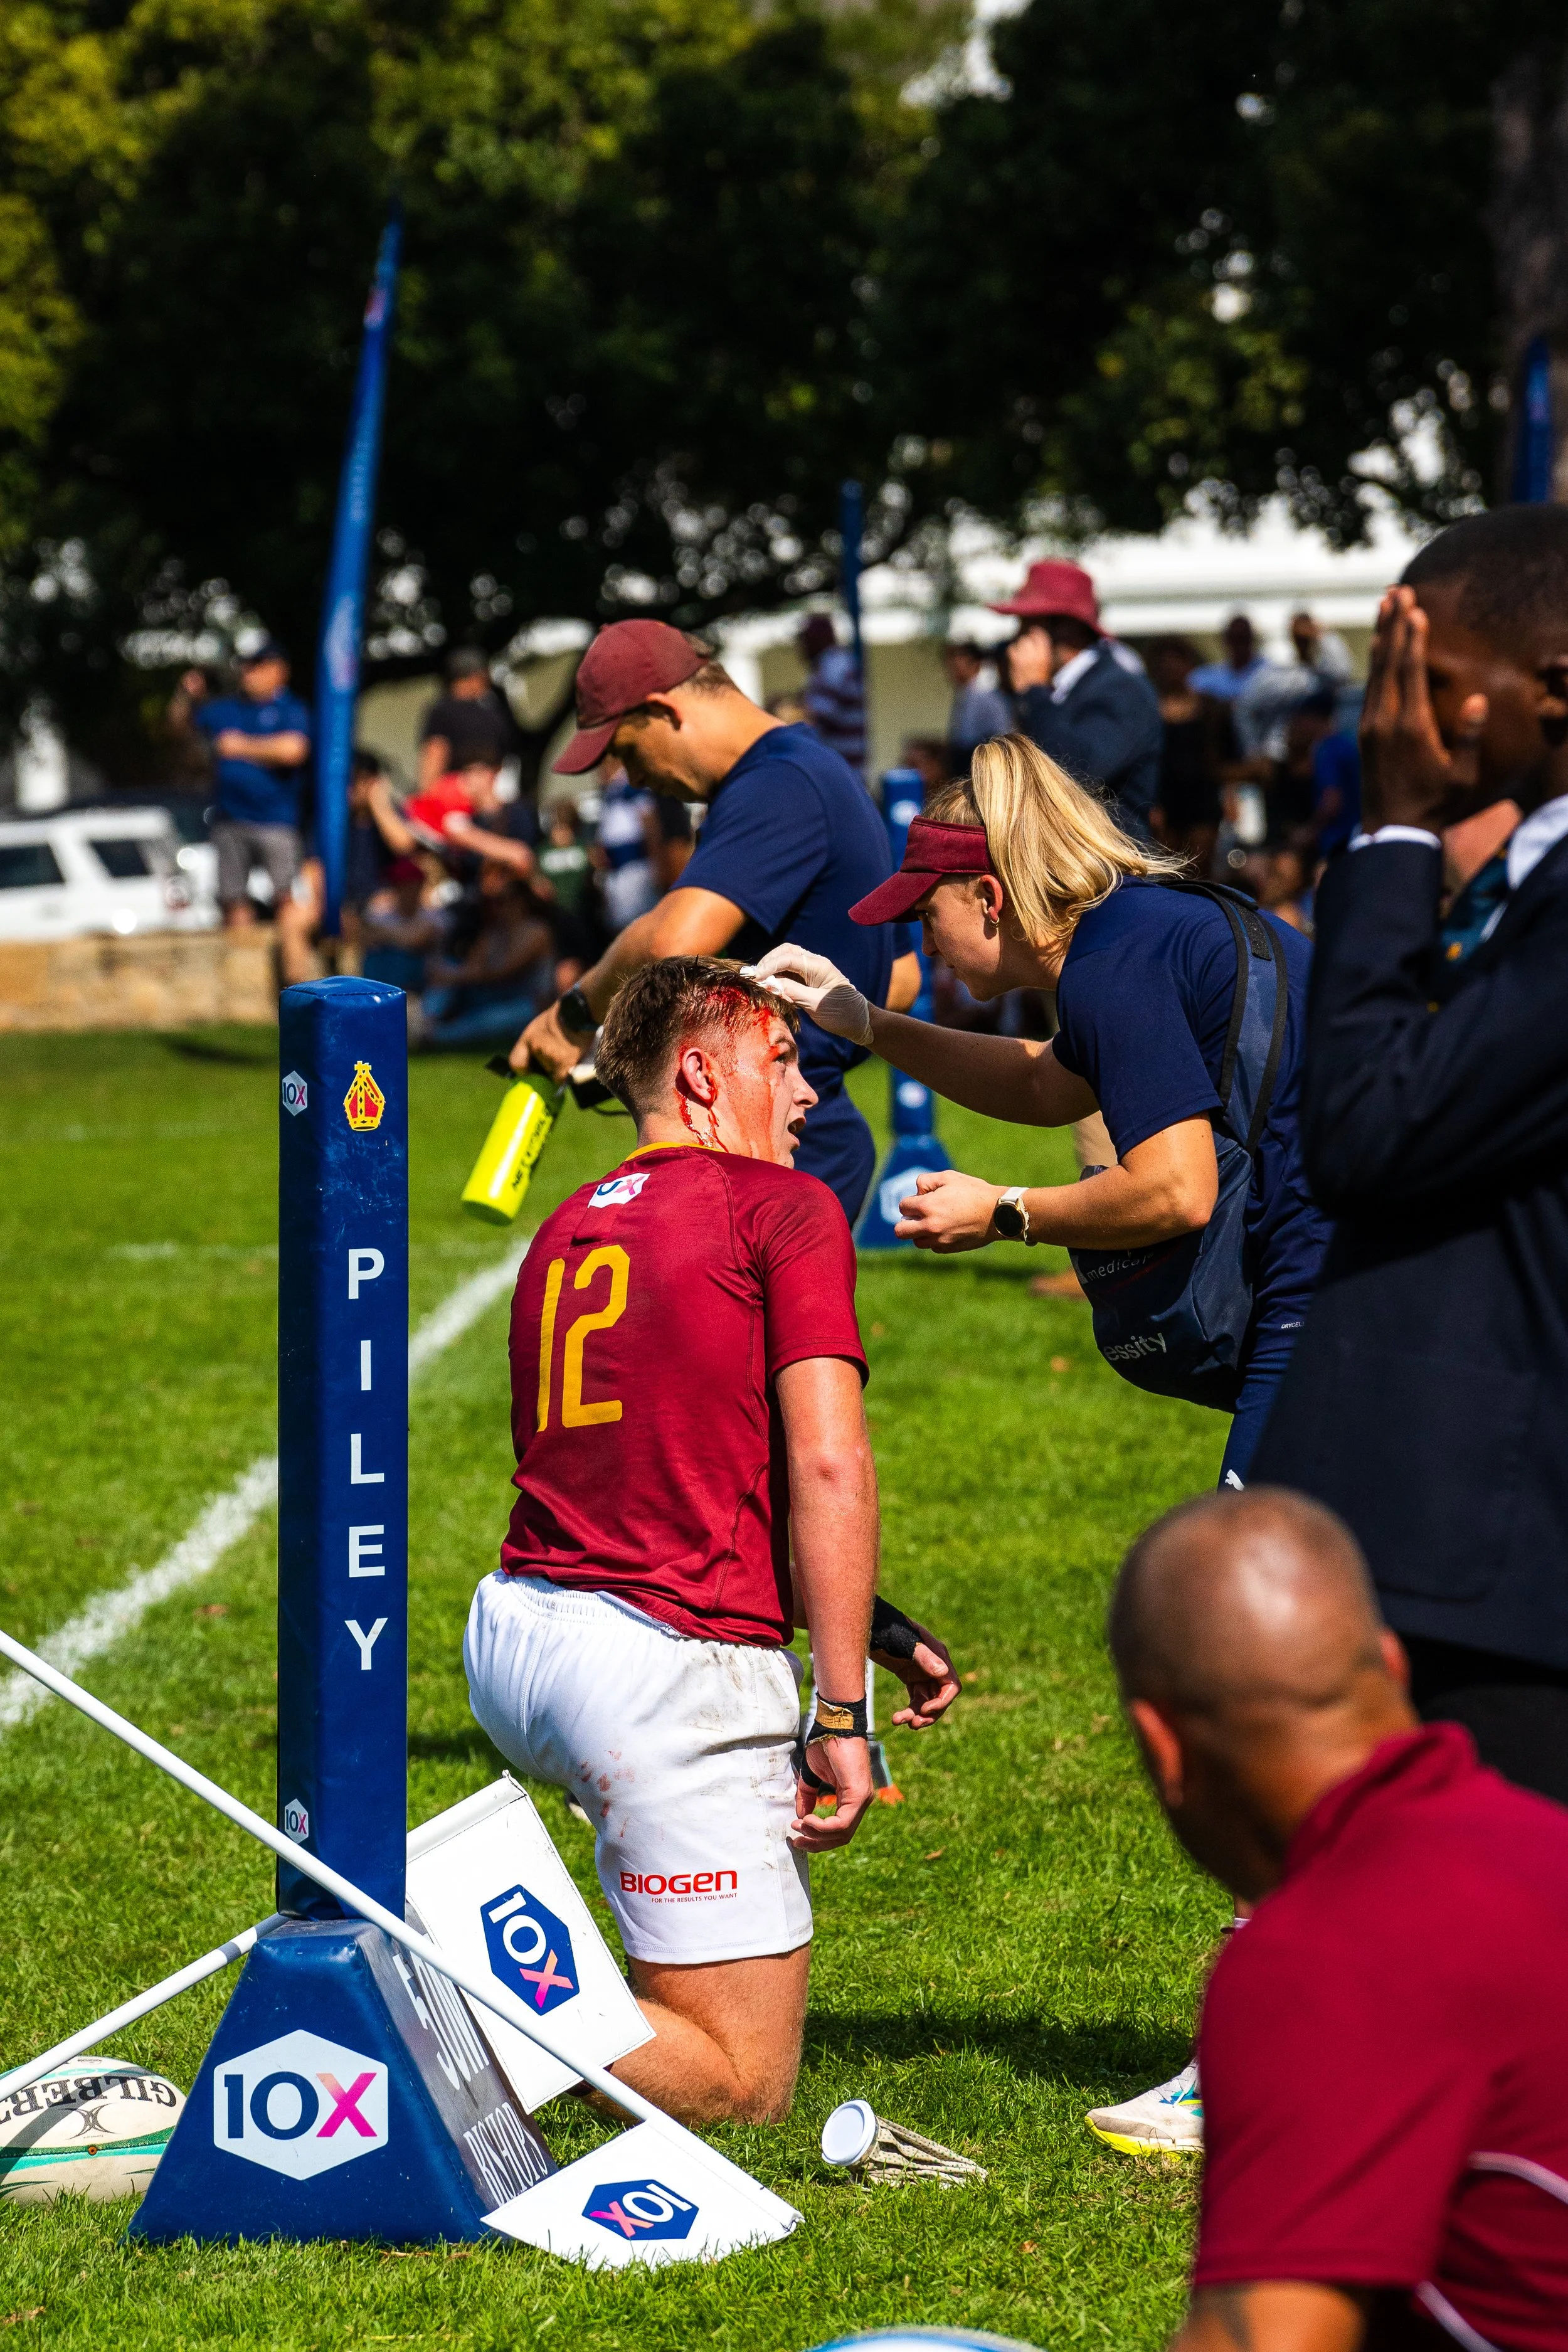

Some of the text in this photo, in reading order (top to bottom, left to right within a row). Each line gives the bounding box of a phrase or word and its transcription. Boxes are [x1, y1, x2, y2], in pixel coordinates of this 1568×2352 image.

[283, 1082, 306, 1106] 10X
[537, 1244, 630, 1433] 12
[1104, 1333, 1167, 1361] essity
[344, 1248, 388, 1671] PILEY
[285, 1809, 307, 1835] 10X
[488, 1891, 574, 2009] 10X
[224, 2071, 378, 2141] 10X
[590, 2183, 692, 2238] 10X
